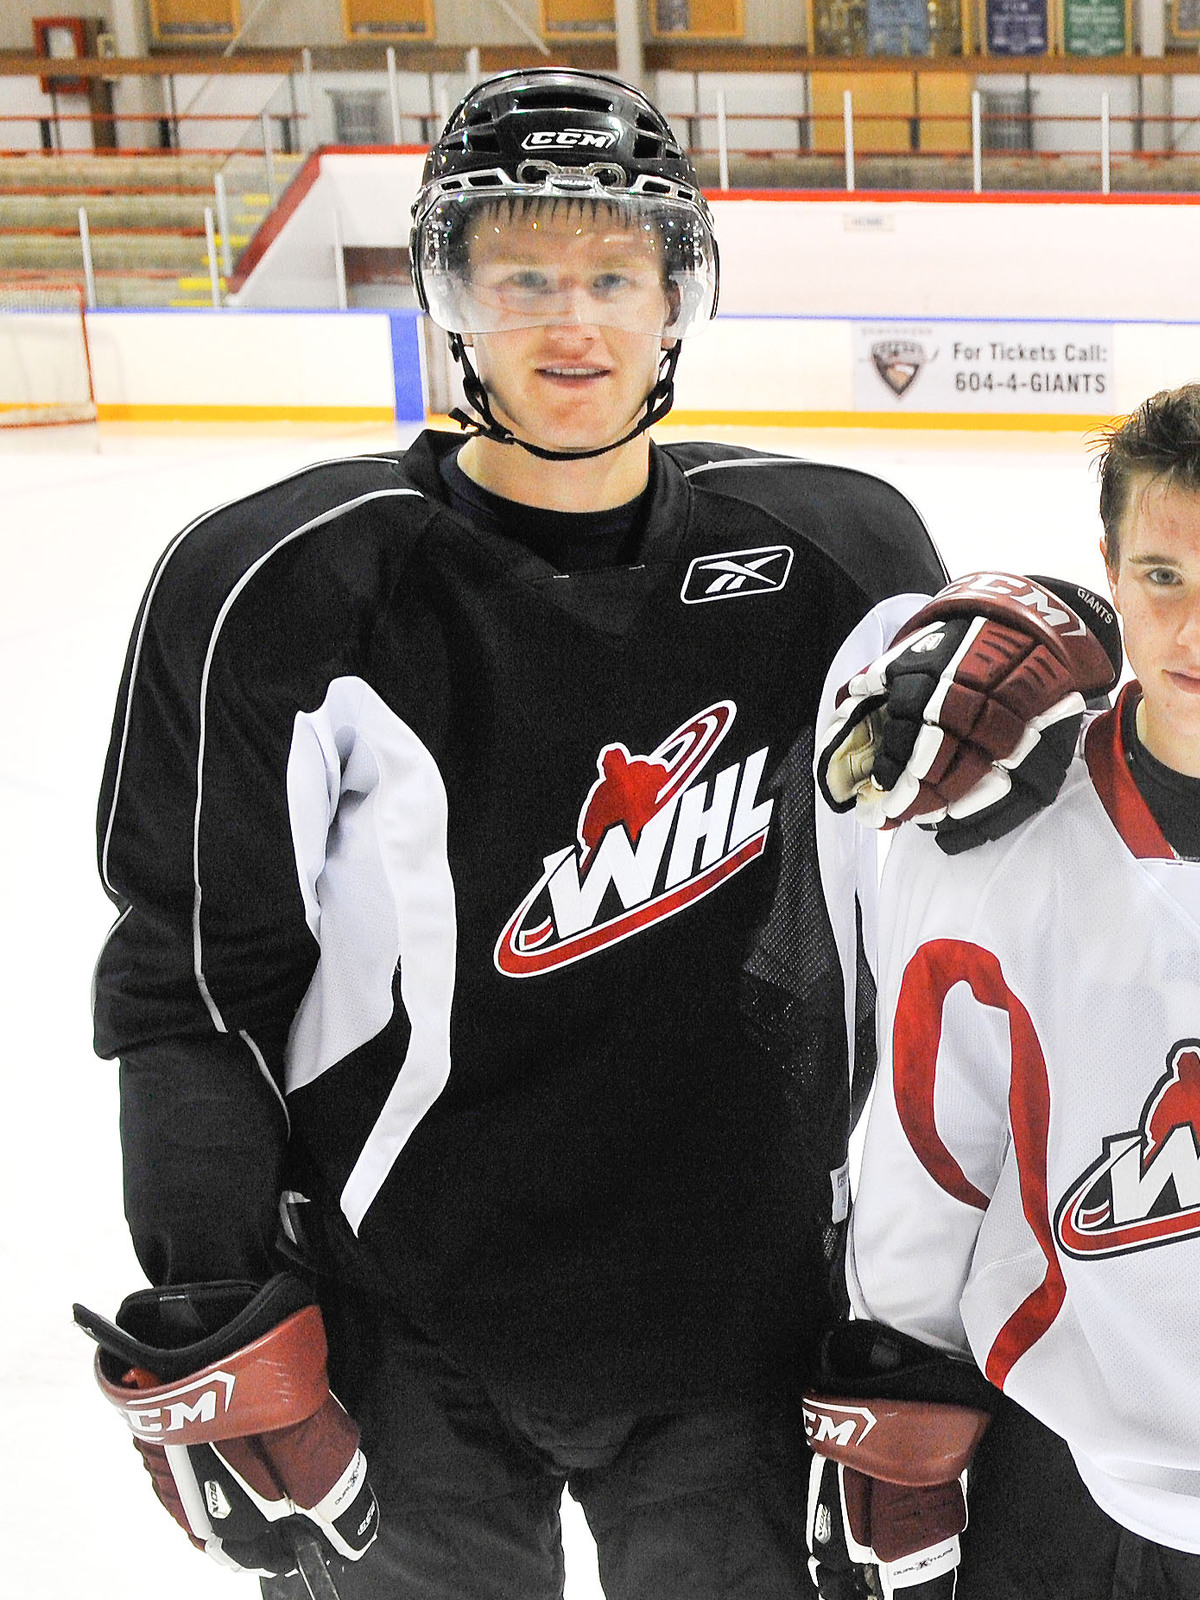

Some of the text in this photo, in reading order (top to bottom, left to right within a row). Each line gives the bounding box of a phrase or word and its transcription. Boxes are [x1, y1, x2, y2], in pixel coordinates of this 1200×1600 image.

[530, 131, 610, 148] CCM
[953, 342, 1108, 362] For Tickets Call:
[955, 372, 1106, 393] 604-4-GIANTS
[1077, 588, 1114, 625] GIANTS
[542, 746, 774, 939] WHL
[120, 1390, 217, 1431] CM
[802, 1407, 858, 1446] CM
